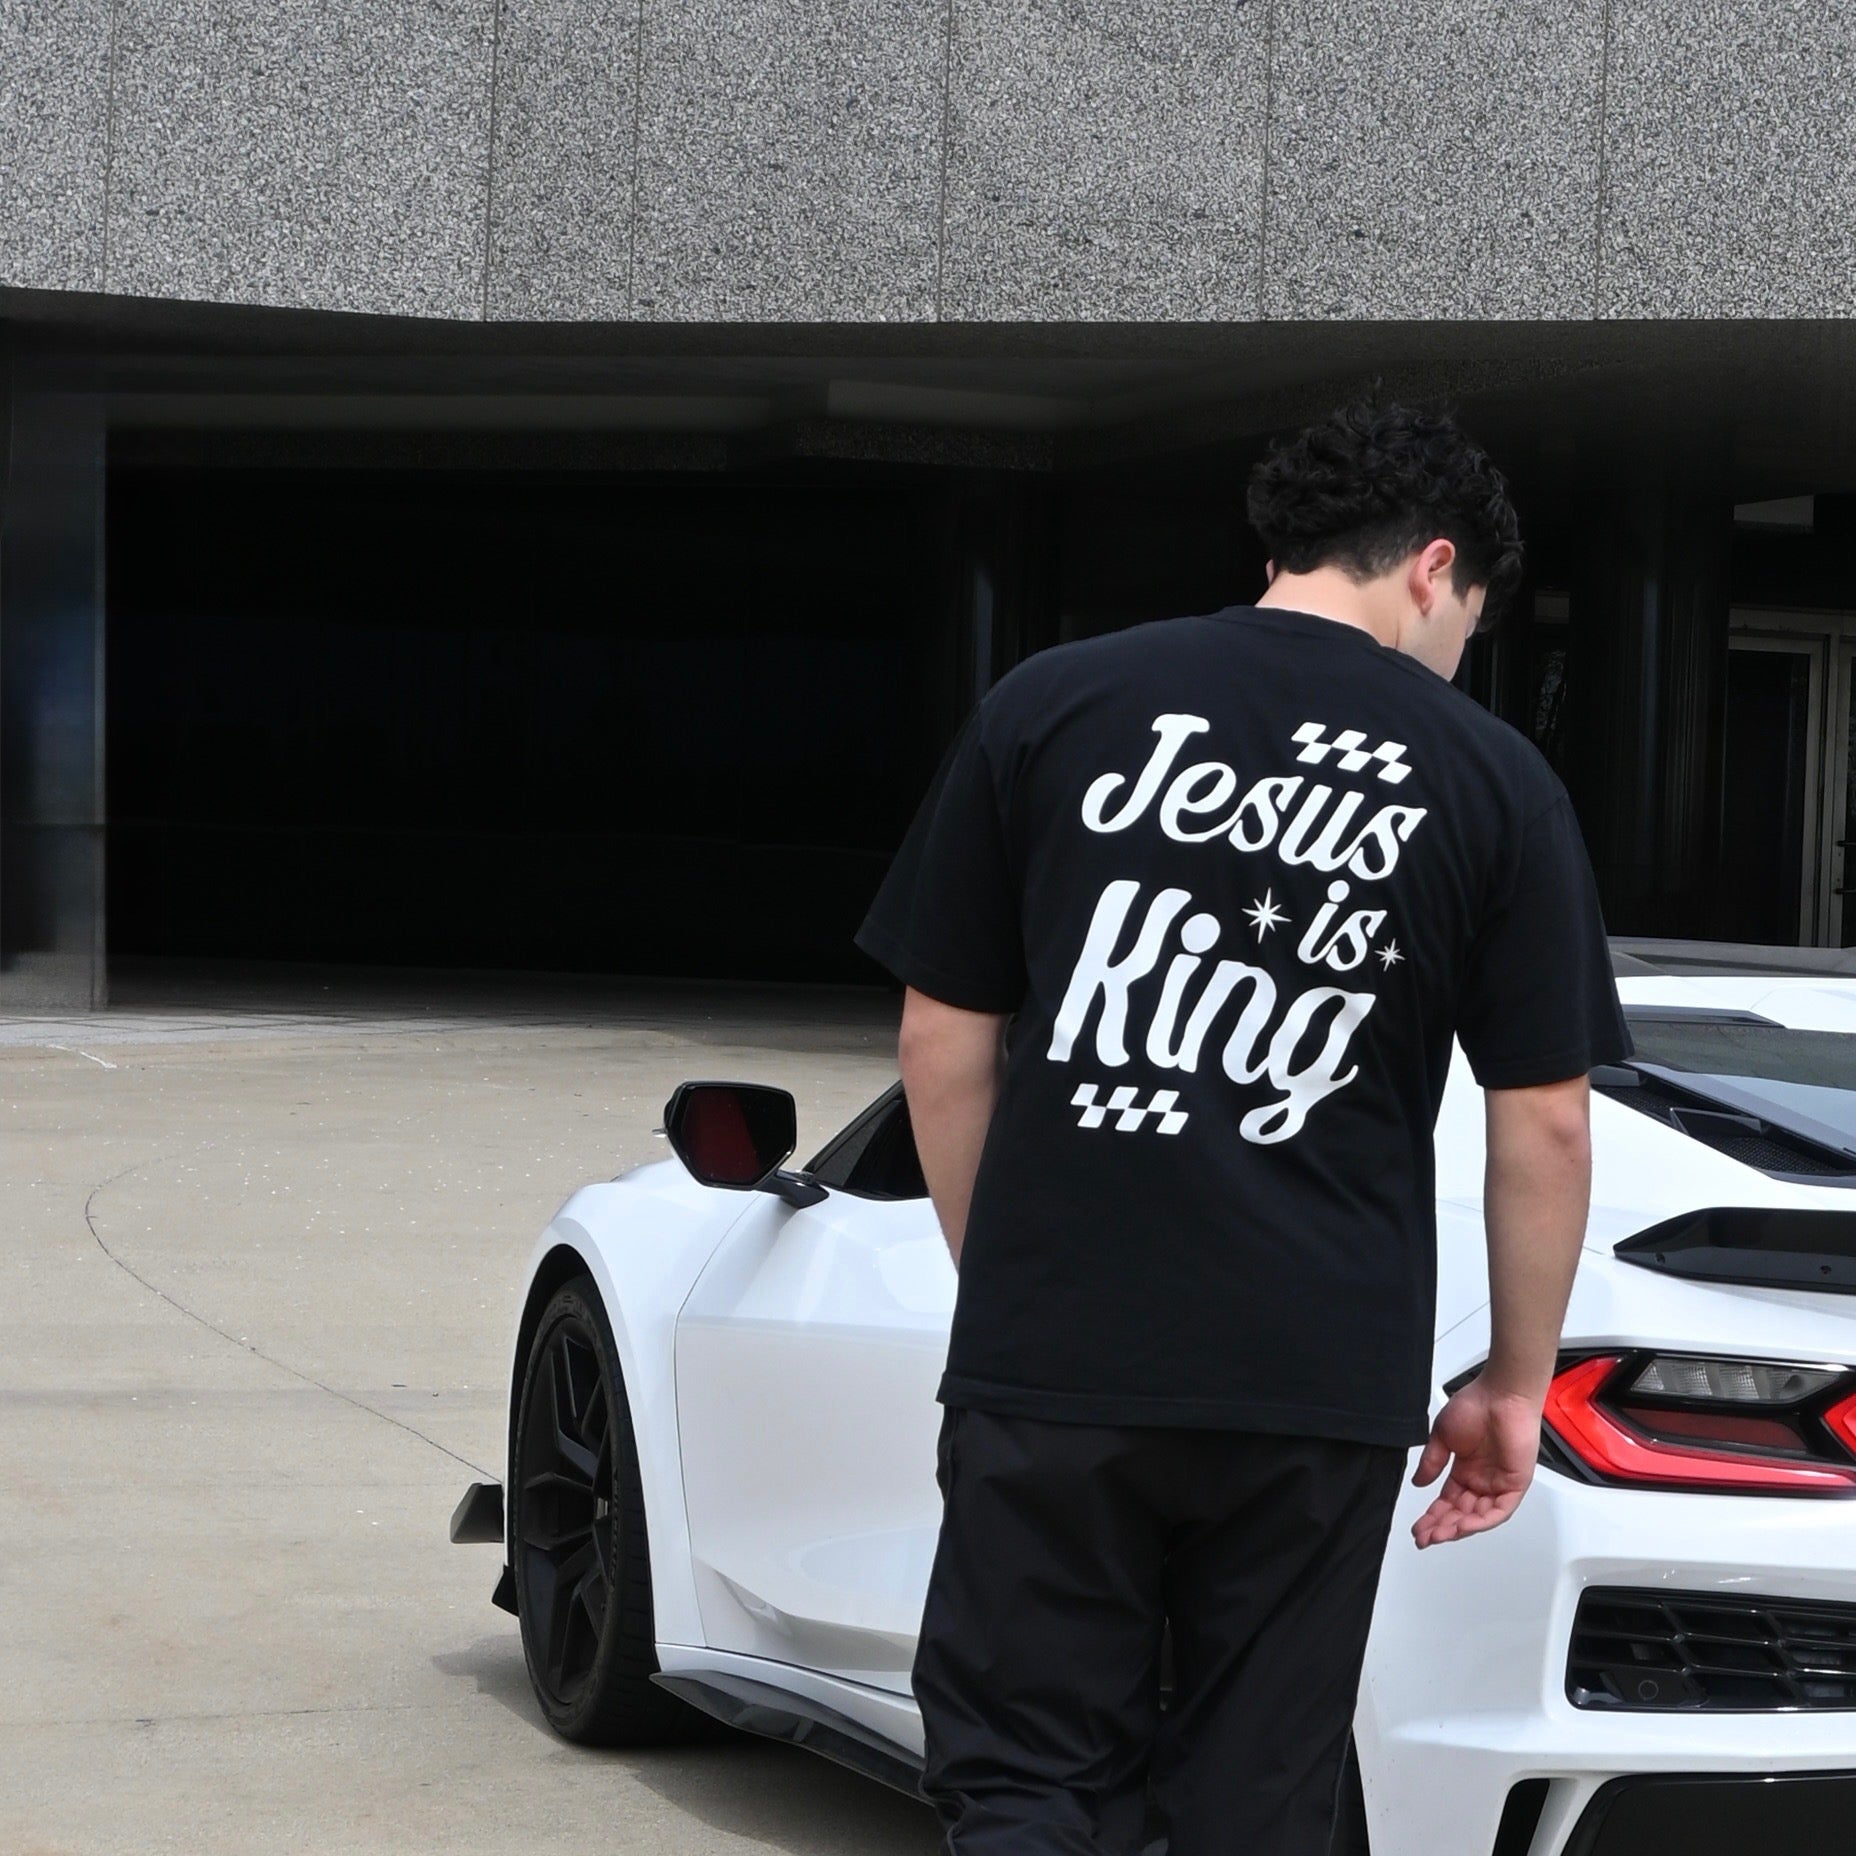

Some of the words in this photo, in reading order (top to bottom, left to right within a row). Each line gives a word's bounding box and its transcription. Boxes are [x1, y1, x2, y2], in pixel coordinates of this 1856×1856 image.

[1081, 713, 1428, 881] Jesus
[1297, 879, 1388, 972] is
[1046, 879, 1377, 1145] King
